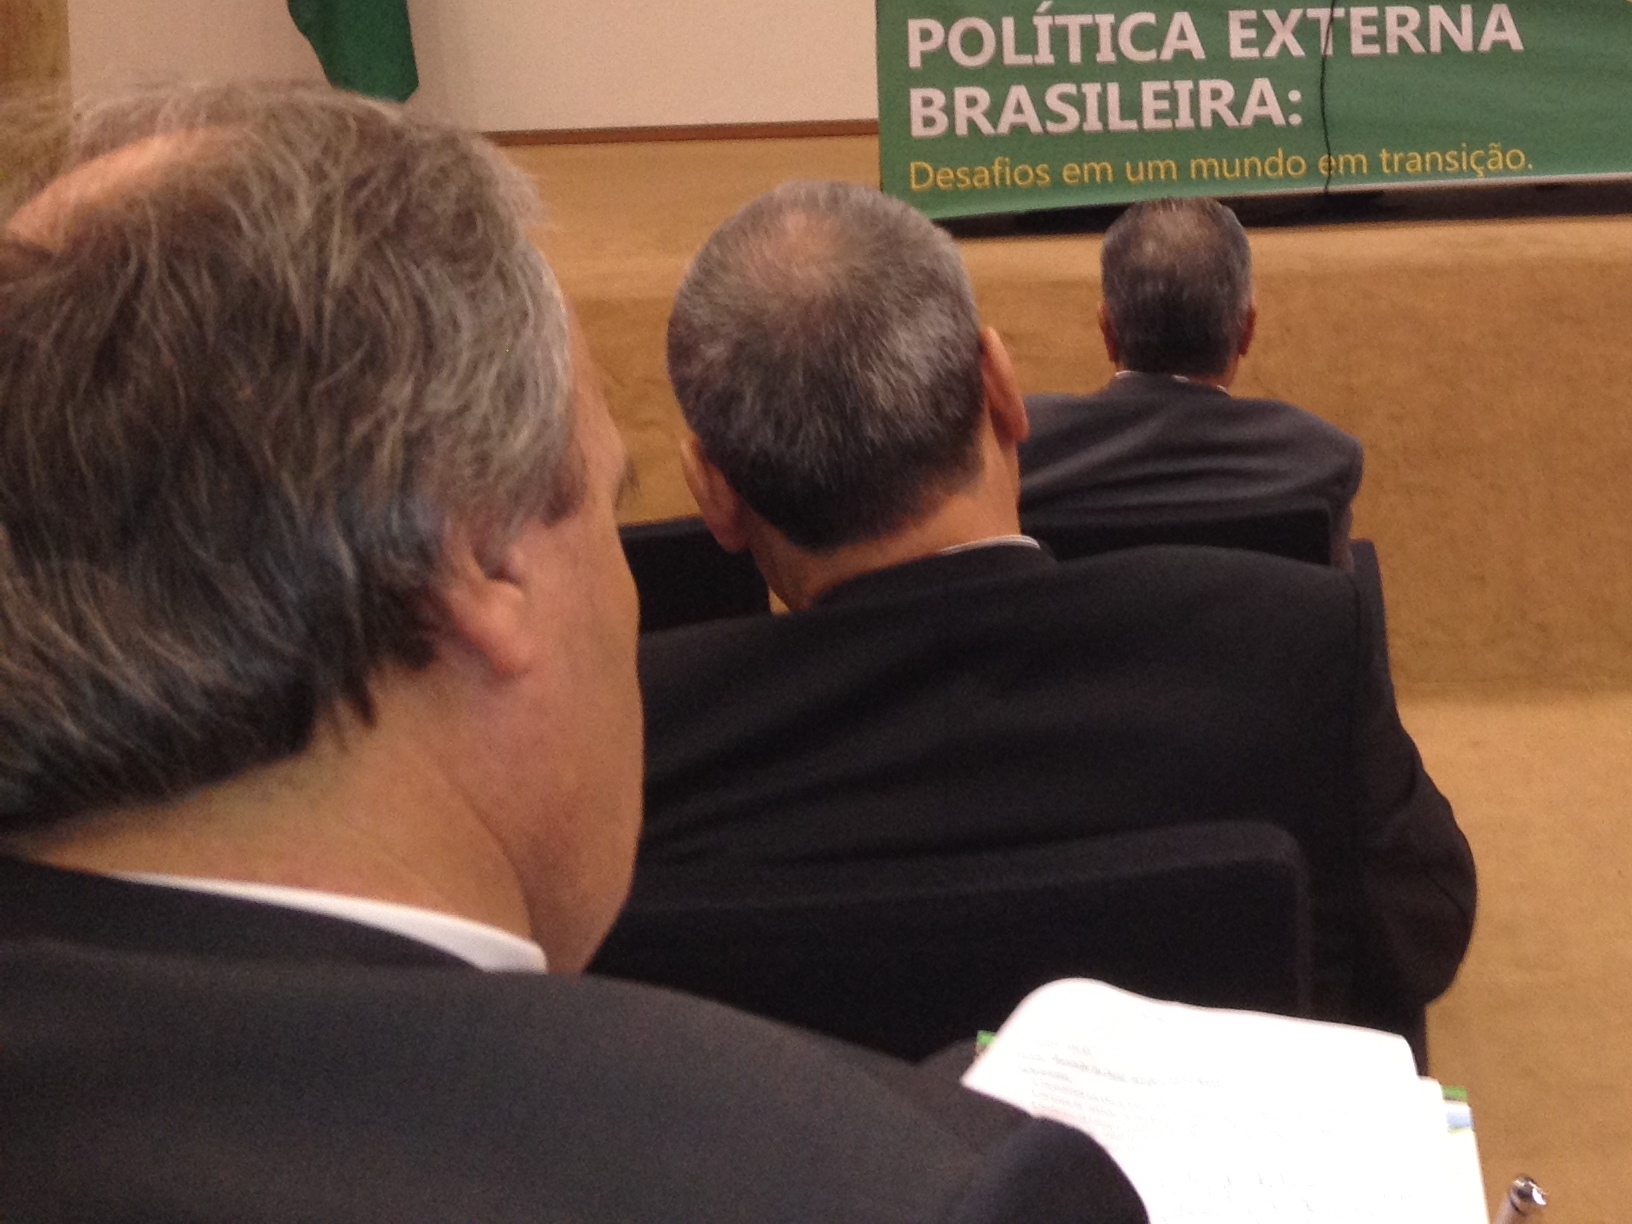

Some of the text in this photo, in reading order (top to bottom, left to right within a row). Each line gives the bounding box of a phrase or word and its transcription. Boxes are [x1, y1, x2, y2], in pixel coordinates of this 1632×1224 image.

[907, 1, 1524, 69] POLÍTICA EXTERNA
[909, 77, 1302, 138] BRASILEIRA:
[909, 143, 1534, 191] Desafios em um mundo em transição.
